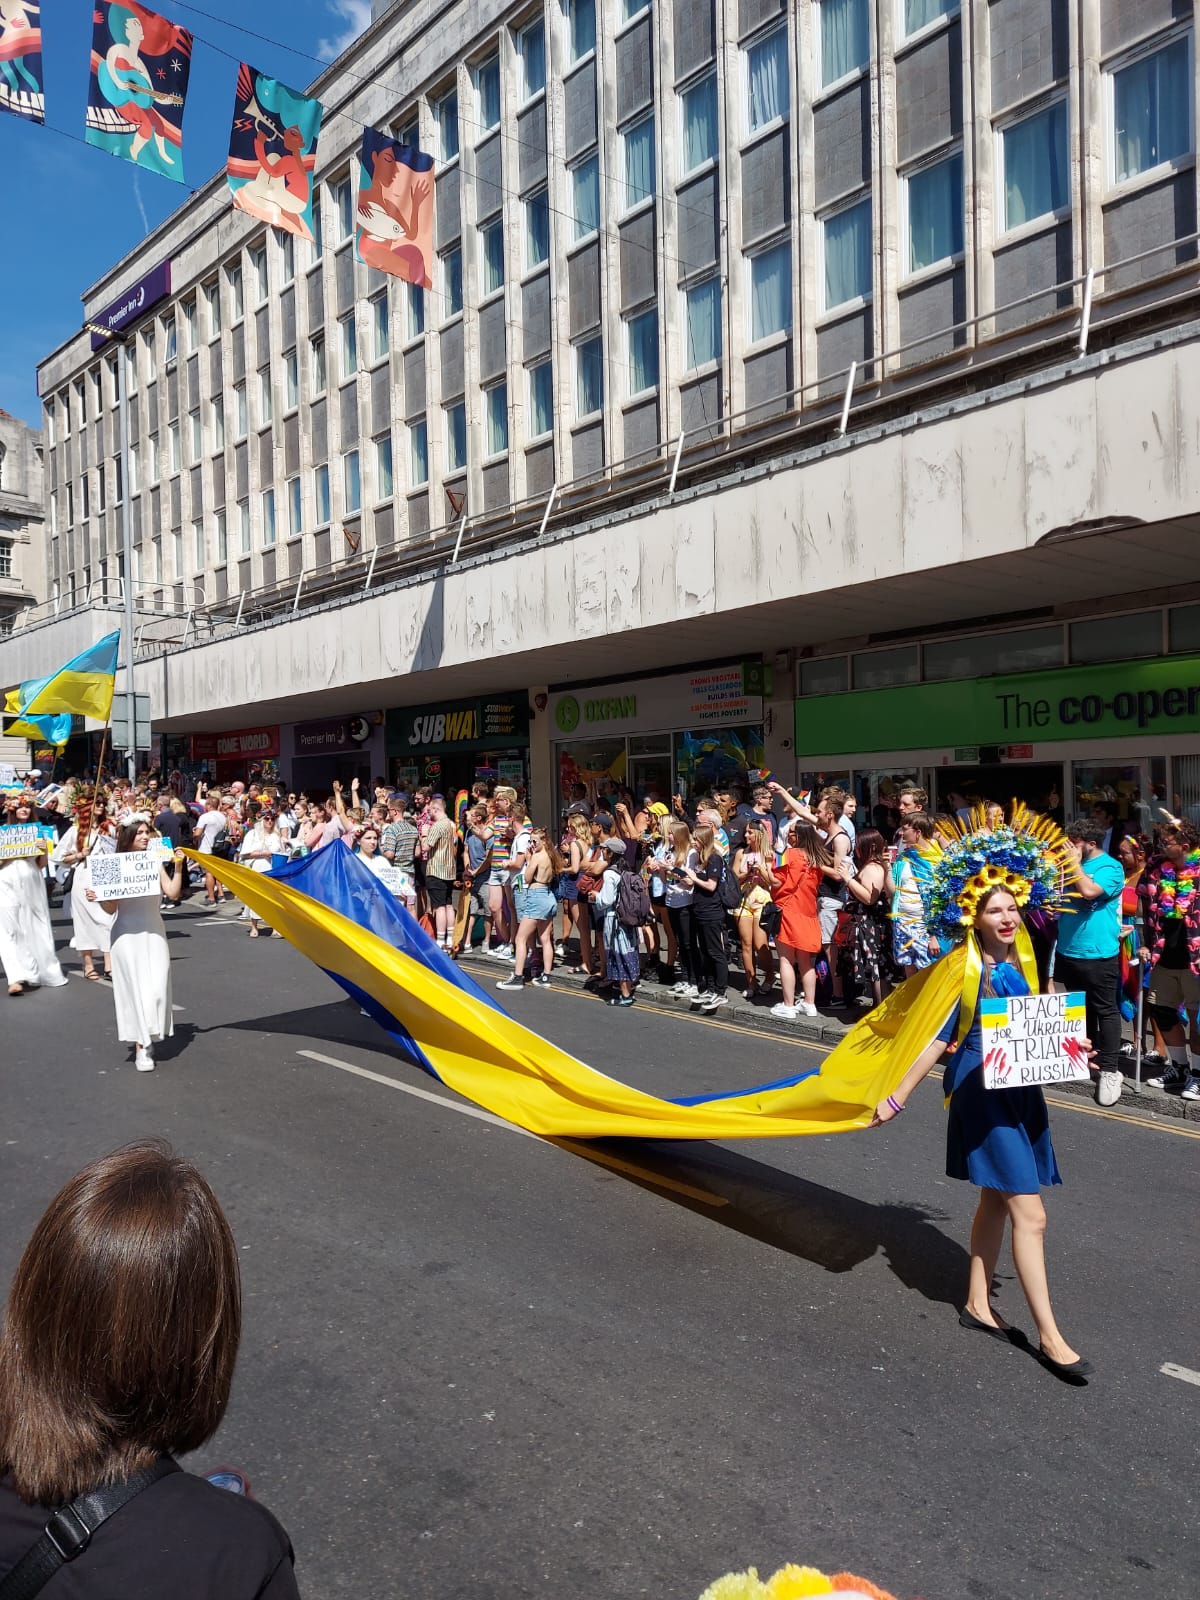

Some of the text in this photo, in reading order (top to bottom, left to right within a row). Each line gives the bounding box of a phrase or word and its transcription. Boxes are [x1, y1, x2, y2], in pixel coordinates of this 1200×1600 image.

[108, 299, 137, 327] Premier Inn
[708, 692, 729, 701] BUILDS
[584, 695, 637, 722] OXFAM
[699, 709, 748, 719] FIGHTS POVERTY
[996, 694, 1050, 729] The
[217, 738, 240, 754] FONE
[240, 733, 270, 750] WORLD
[300, 731, 336, 745] Premier Inn
[135, 861, 156, 871] OUT
[103, 881, 151, 898] EMBASSY!
[1008, 995, 1070, 1021] PEACE
[1008, 1036, 1069, 1062] TRIAL
